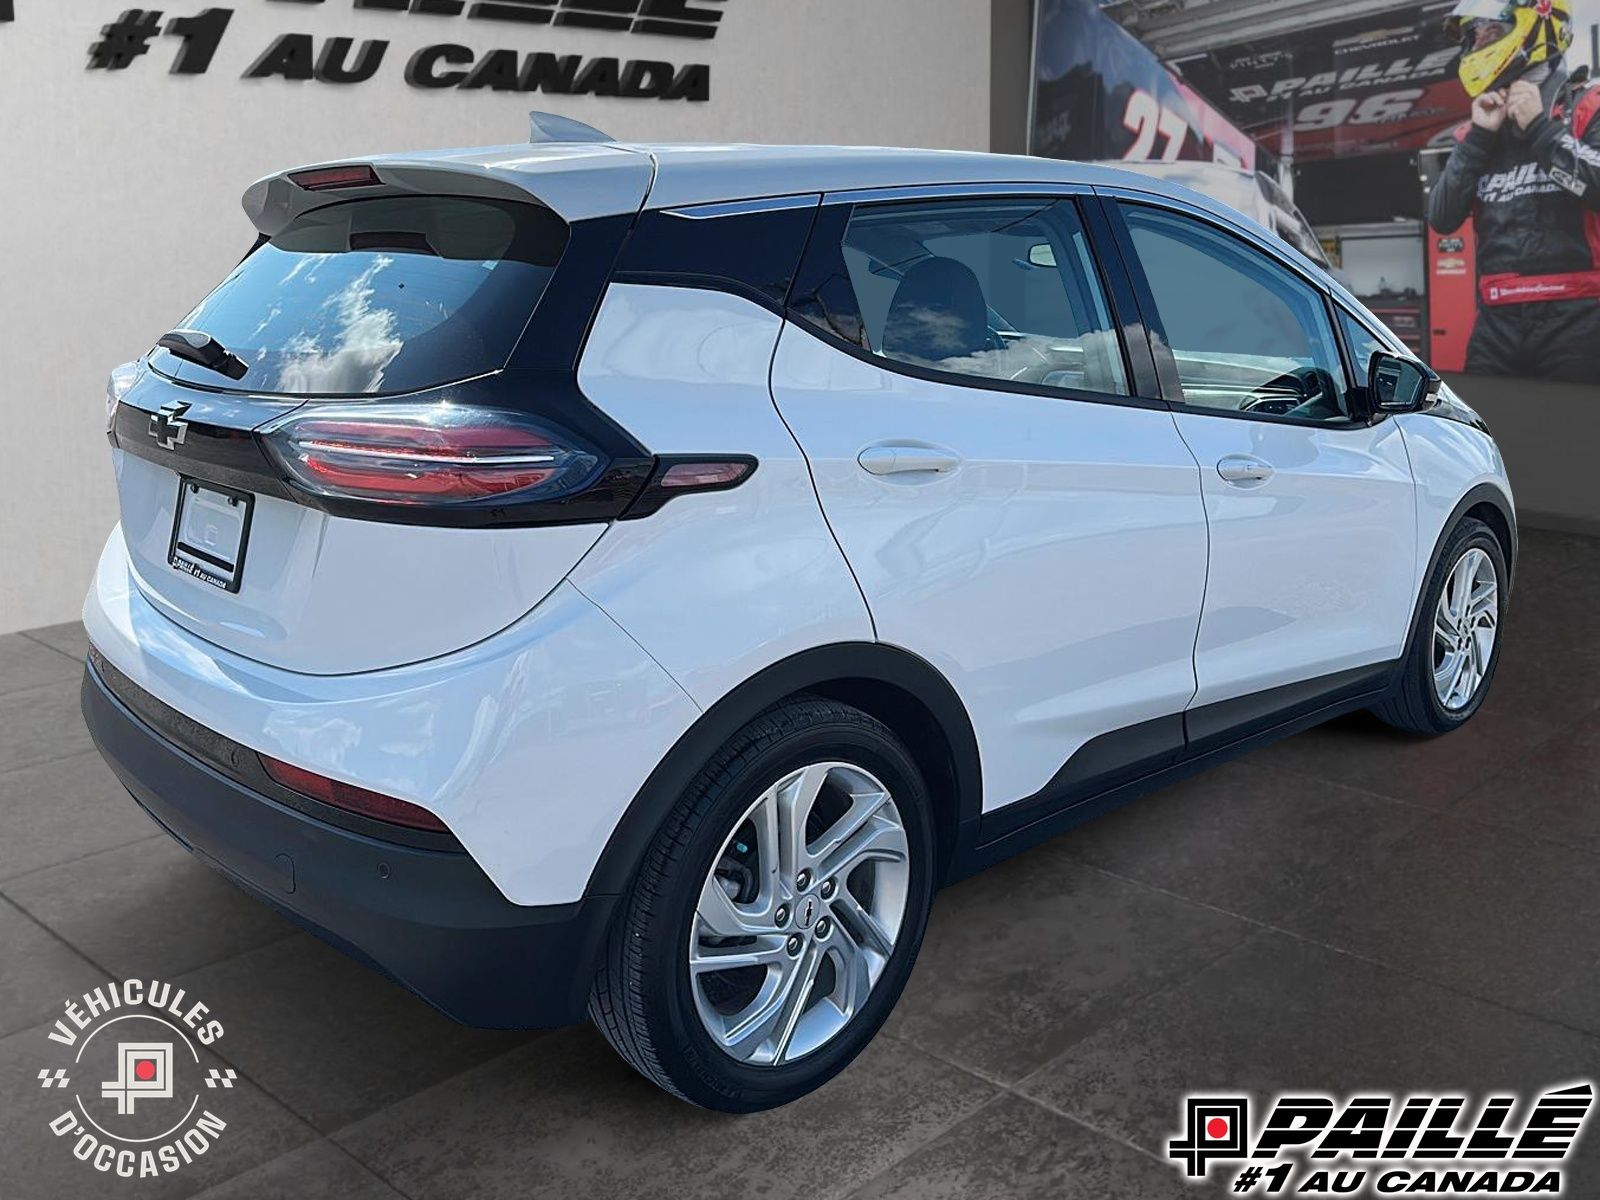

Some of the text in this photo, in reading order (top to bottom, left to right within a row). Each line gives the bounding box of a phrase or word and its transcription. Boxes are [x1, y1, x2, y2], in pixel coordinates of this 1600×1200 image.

[85, 8, 235, 75] #1
[240, 32, 391, 84] AU
[404, 44, 710, 101] CANADA
[1299, 86, 1330, 97] AU
[1342, 67, 1446, 88] CANADA
